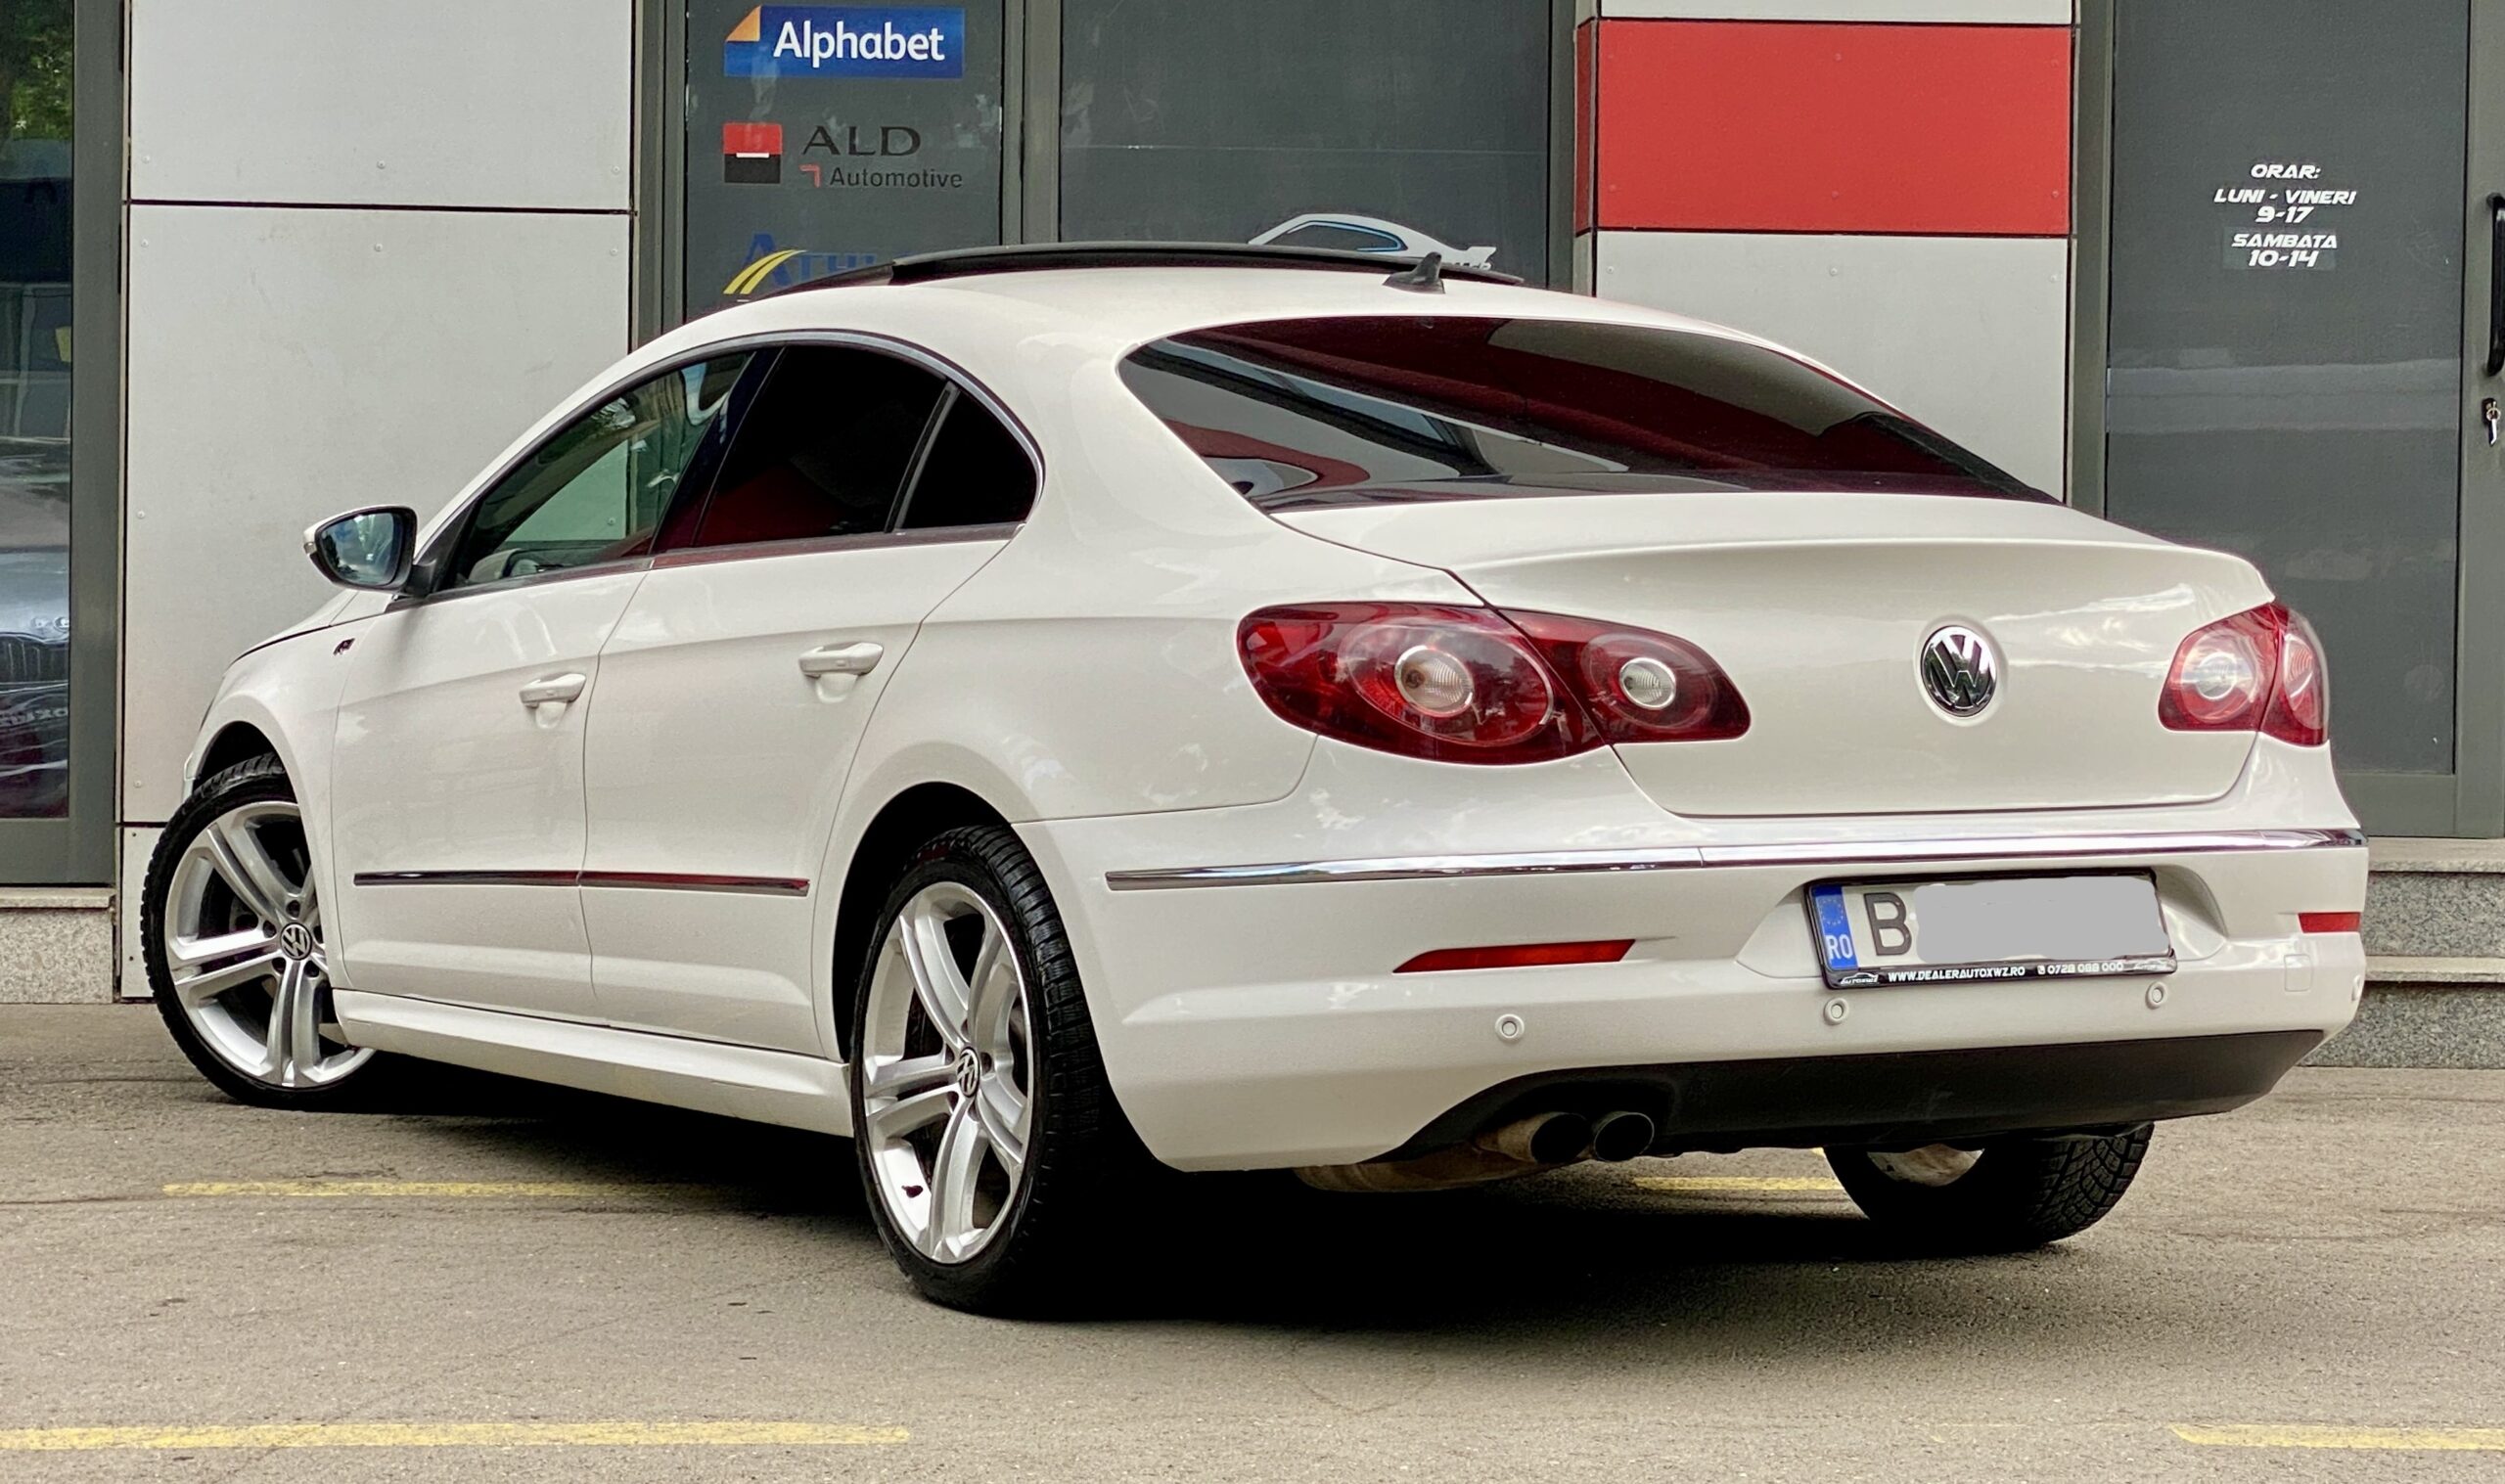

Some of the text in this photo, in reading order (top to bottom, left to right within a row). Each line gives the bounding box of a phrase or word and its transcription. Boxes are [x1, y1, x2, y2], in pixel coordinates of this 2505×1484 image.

[773, 21, 945, 68] Alphabet
[802, 125, 922, 157] ALD
[830, 167, 963, 188] Automotive
[2251, 163, 2321, 179] ORAR:
[2213, 189, 2266, 203] LUNI
[2285, 190, 2357, 204] VINERI
[2255, 205, 2314, 223] 9-17
[2231, 233, 2338, 248] SAMBATA
[2249, 249, 2319, 268] 10-14
[1920, 625, 1997, 717] VW
[1863, 892, 1912, 957] B
[280, 922, 312, 961] VW
[1825, 933, 1853, 960] RO
[1888, 967, 2026, 982] WWW.DEALERAUTOXWZ.RO
